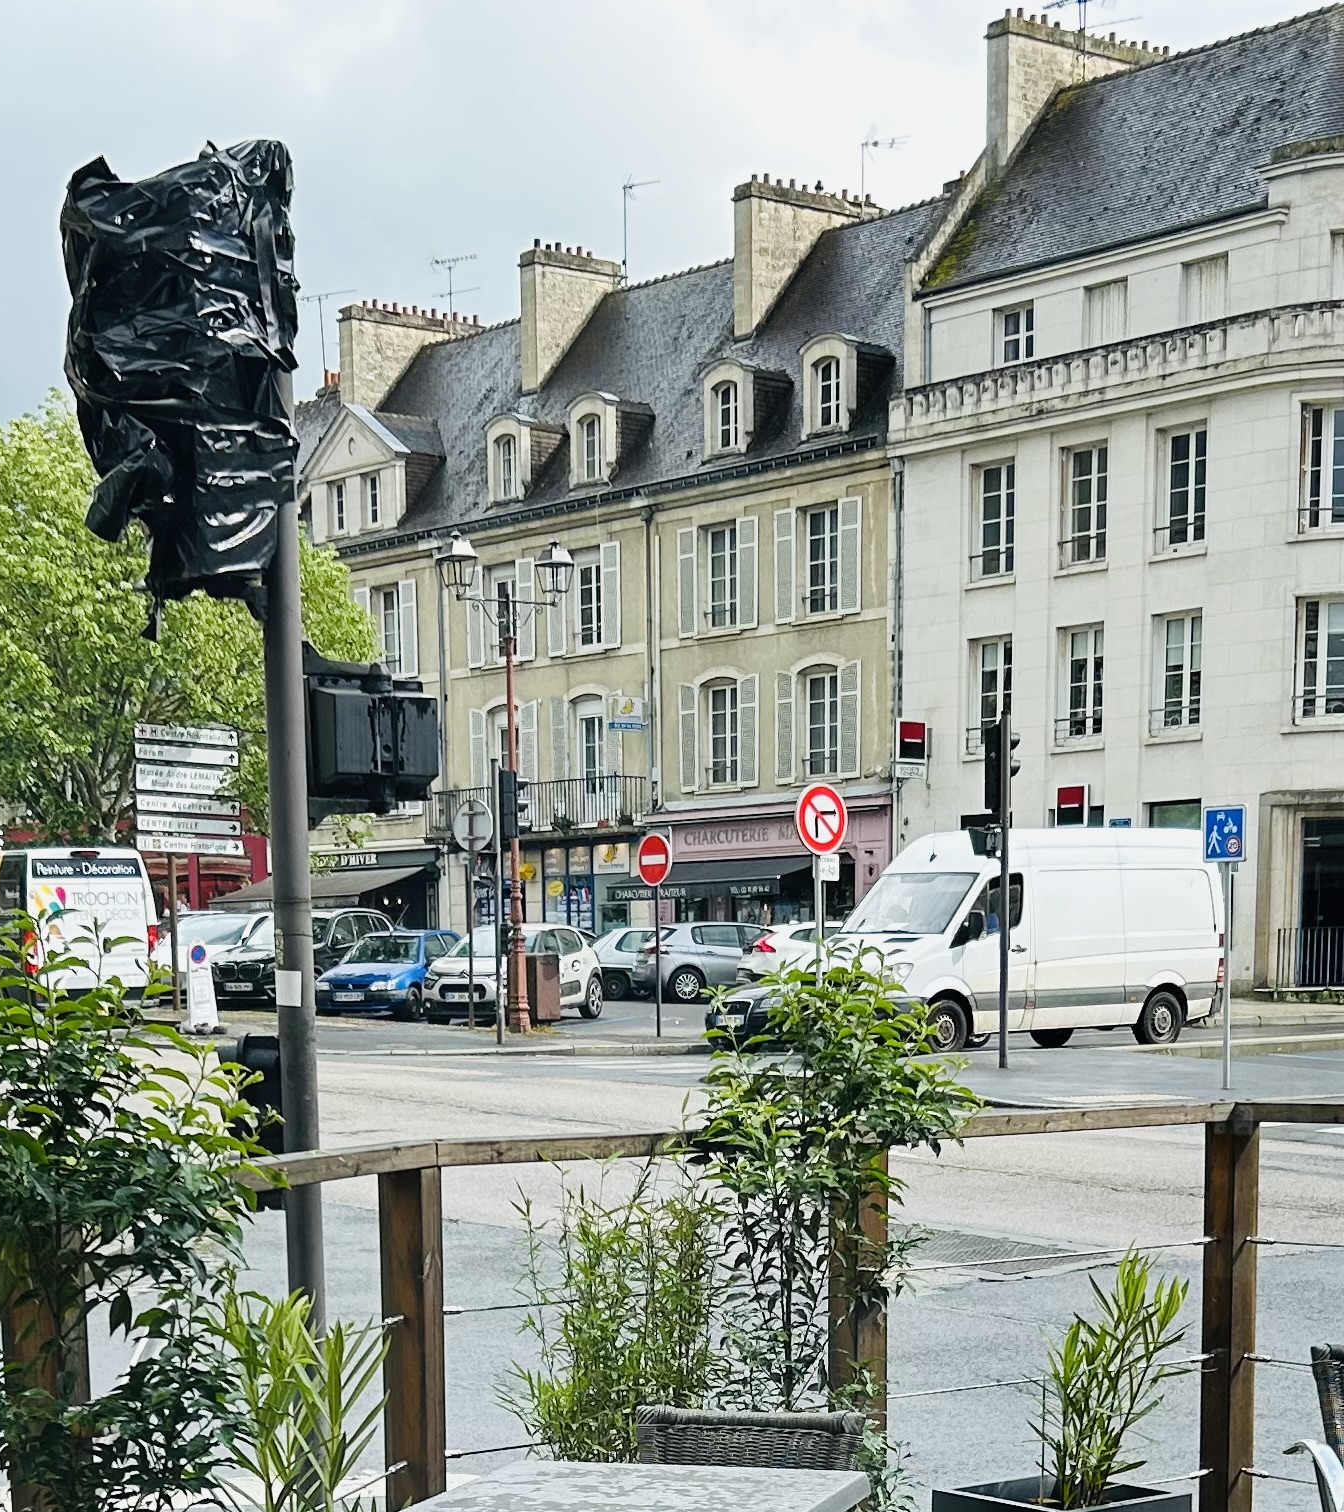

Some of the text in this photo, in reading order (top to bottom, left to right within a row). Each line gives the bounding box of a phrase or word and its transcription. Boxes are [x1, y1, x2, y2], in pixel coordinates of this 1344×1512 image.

[138, 747, 164, 757] Forum
[140, 799, 167, 809] Centre
[140, 818, 199, 830] CENTRE VILLE
[684, 827, 769, 846] CHARCUTERIE
[163, 840, 188, 849] Centre
[340, 853, 377, 866] D'HIVER
[36, 862, 74, 875] Peinture
[81, 861, 137, 875] Décoration
[71, 891, 139, 906] TROCHON
